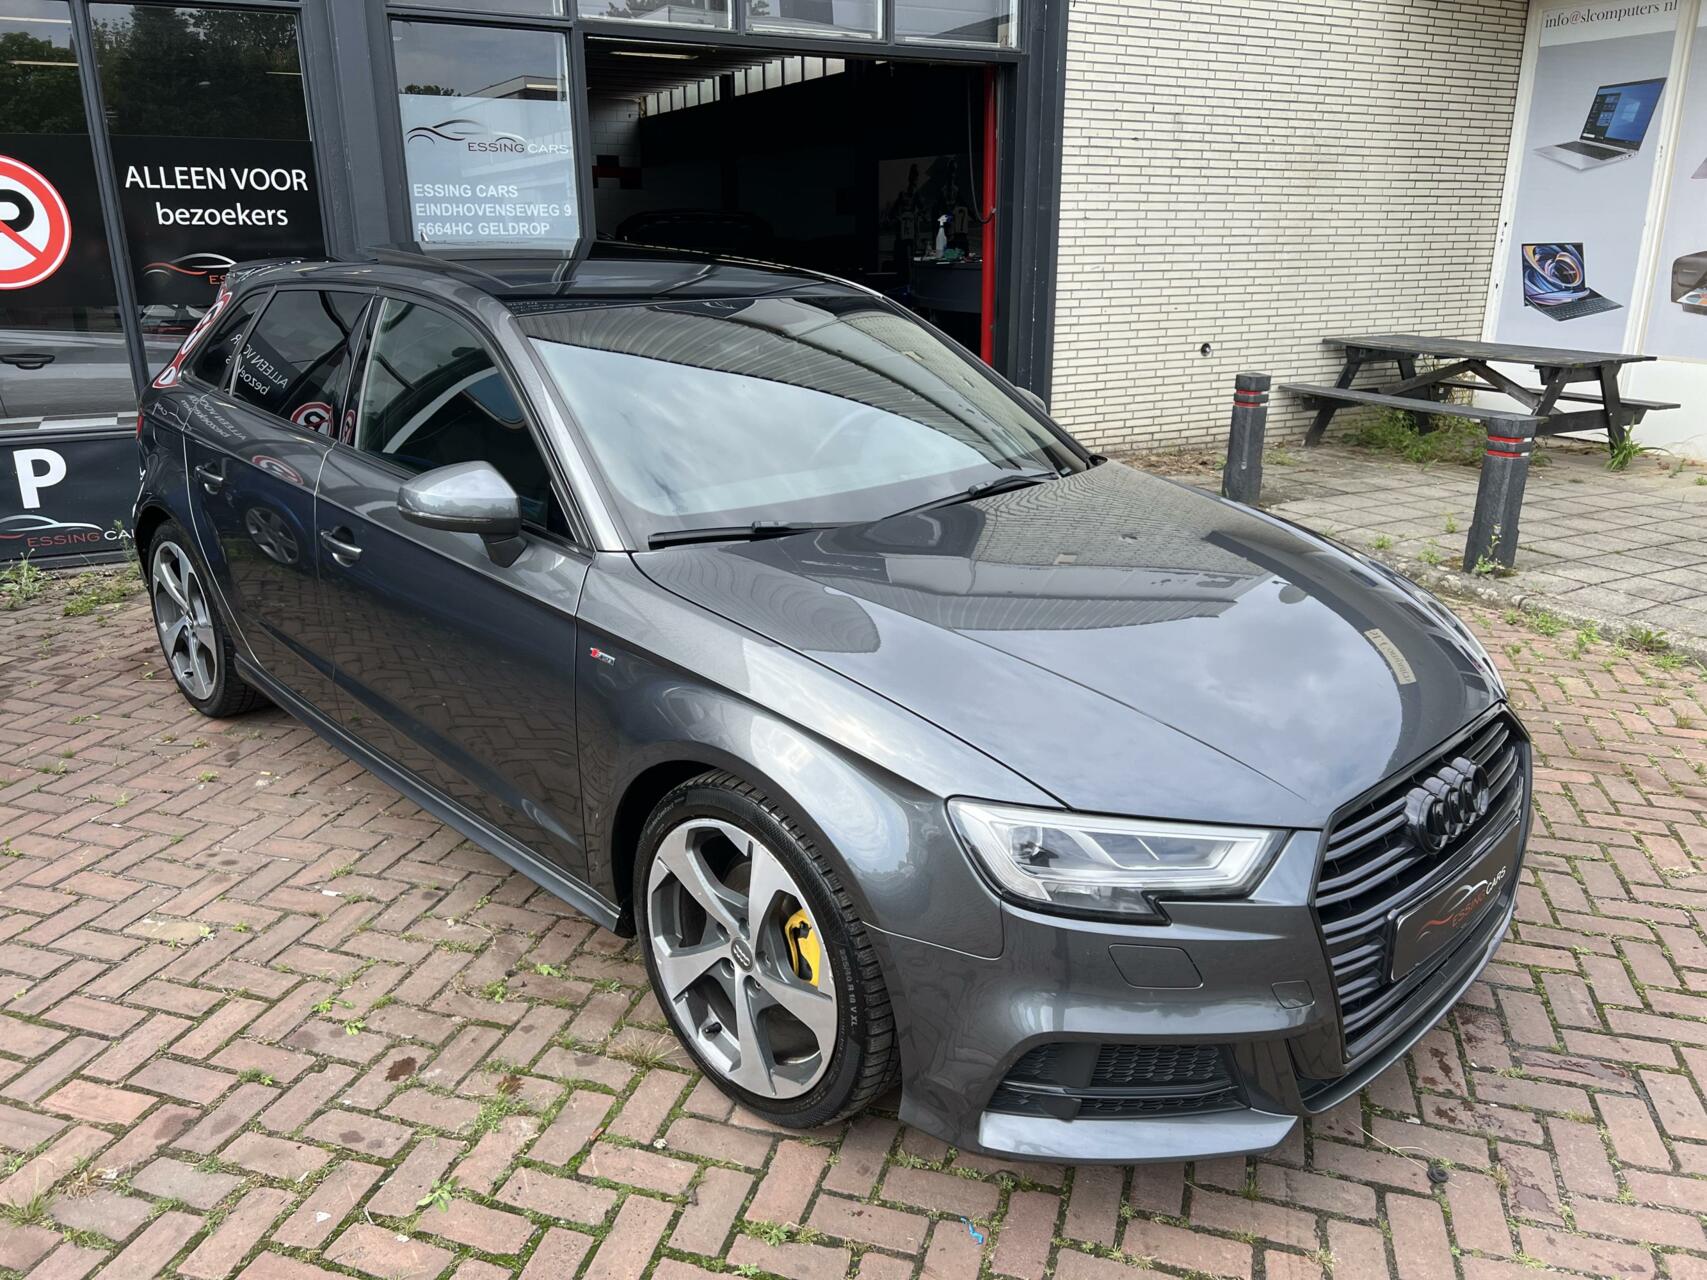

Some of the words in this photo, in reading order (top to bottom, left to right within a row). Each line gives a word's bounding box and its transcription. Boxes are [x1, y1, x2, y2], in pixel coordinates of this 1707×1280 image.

[467, 142, 525, 153] ESSING
[527, 143, 569, 154] CARS
[125, 166, 226, 190] ALLEEN
[230, 168, 309, 191] VOOR
[413, 184, 472, 198] ESSING
[476, 185, 518, 198] CARS
[155, 202, 289, 226] bezoekers
[415, 203, 560, 217] EINDHOVENSEWEG
[564, 204, 572, 217] 9
[418, 222, 473, 235] 5664HC
[478, 222, 550, 235] GELDROP
[13, 448, 67, 509] P
[27, 532, 100, 547] ESSING
[104, 529, 135, 541] CA
